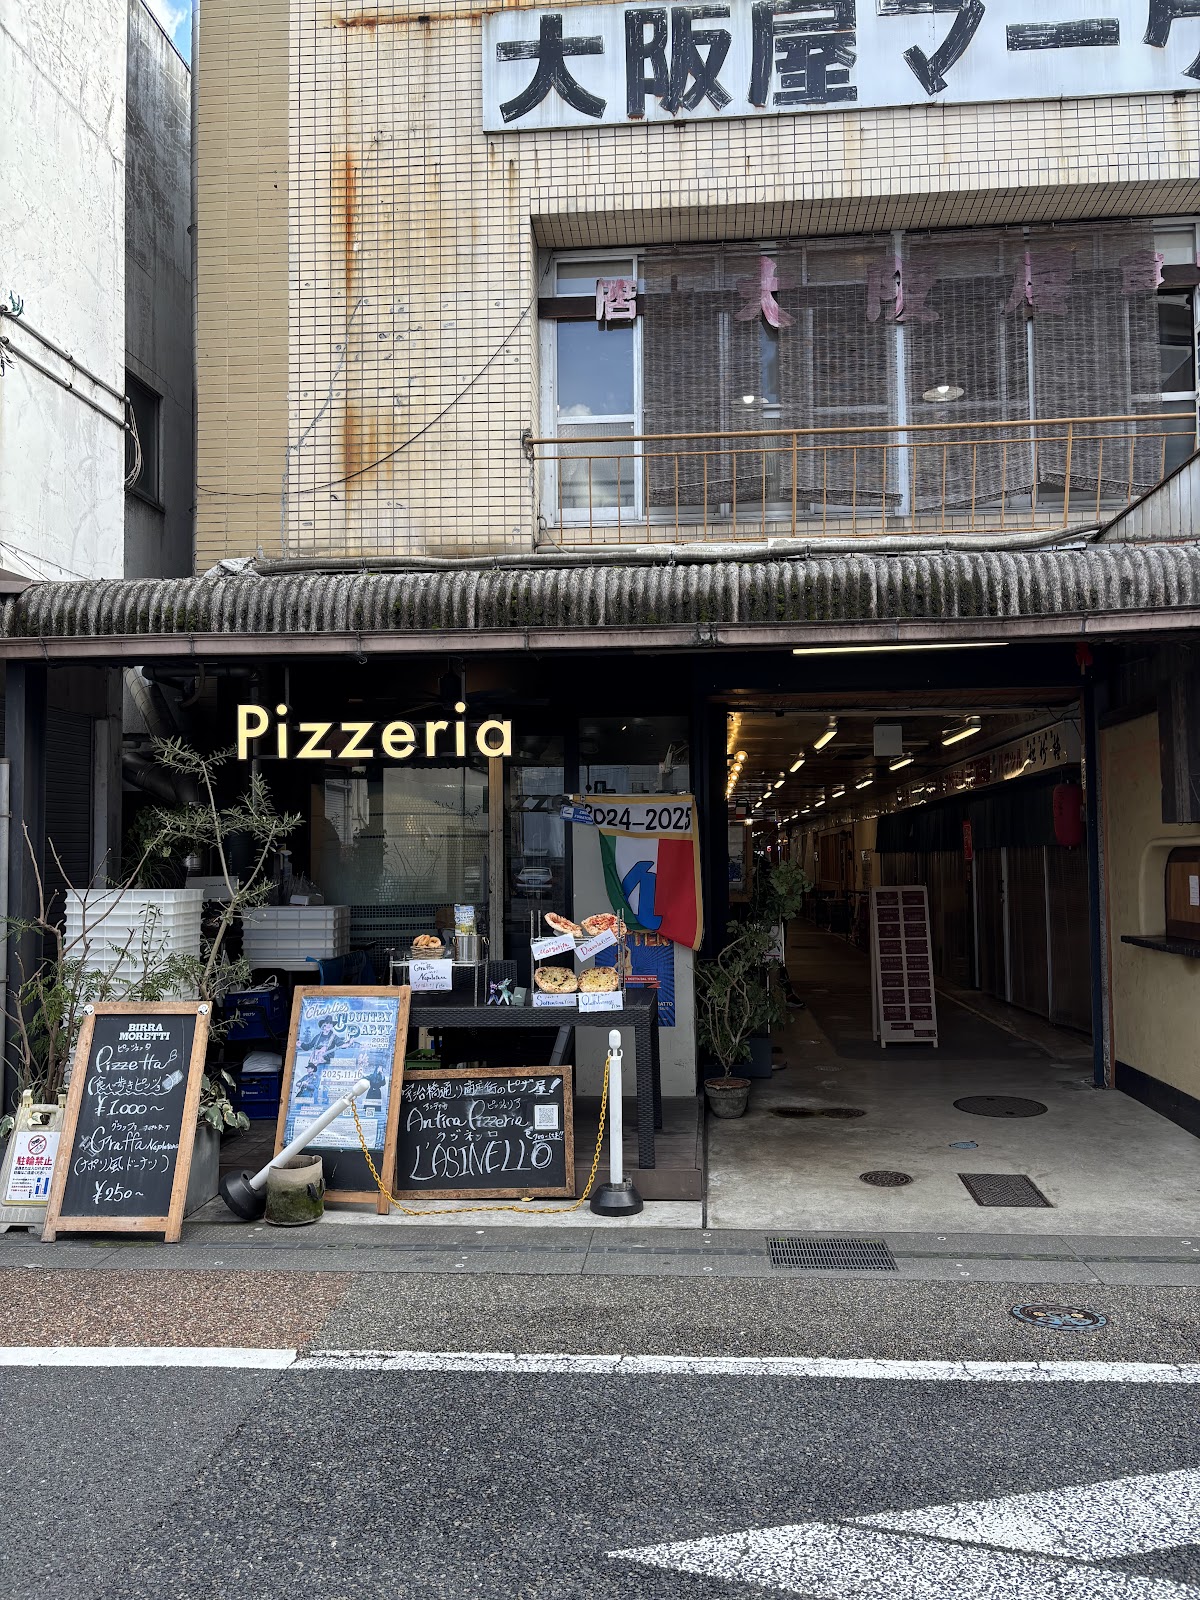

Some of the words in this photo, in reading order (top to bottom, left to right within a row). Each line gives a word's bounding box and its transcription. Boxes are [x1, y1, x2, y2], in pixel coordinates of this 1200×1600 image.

[237, 701, 513, 760] Pizzeria
[128, 1023, 163, 1031] BIRRA
[334, 1010, 393, 1032] COUNTRY
[119, 1031, 170, 1041] MORETTI
[345, 1024, 393, 1041] PARTY
[96, 1045, 169, 1073] Pizzetta
[321, 1068, 363, 1080] 2025.11.16
[407, 1107, 467, 1131] Antica
[468, 1099, 528, 1131] Pizzeria
[91, 1126, 147, 1153] Graffa
[16, 1156, 52, 1166] 駐輪禁止
[409, 1139, 553, 1181] L'ASINELLO
